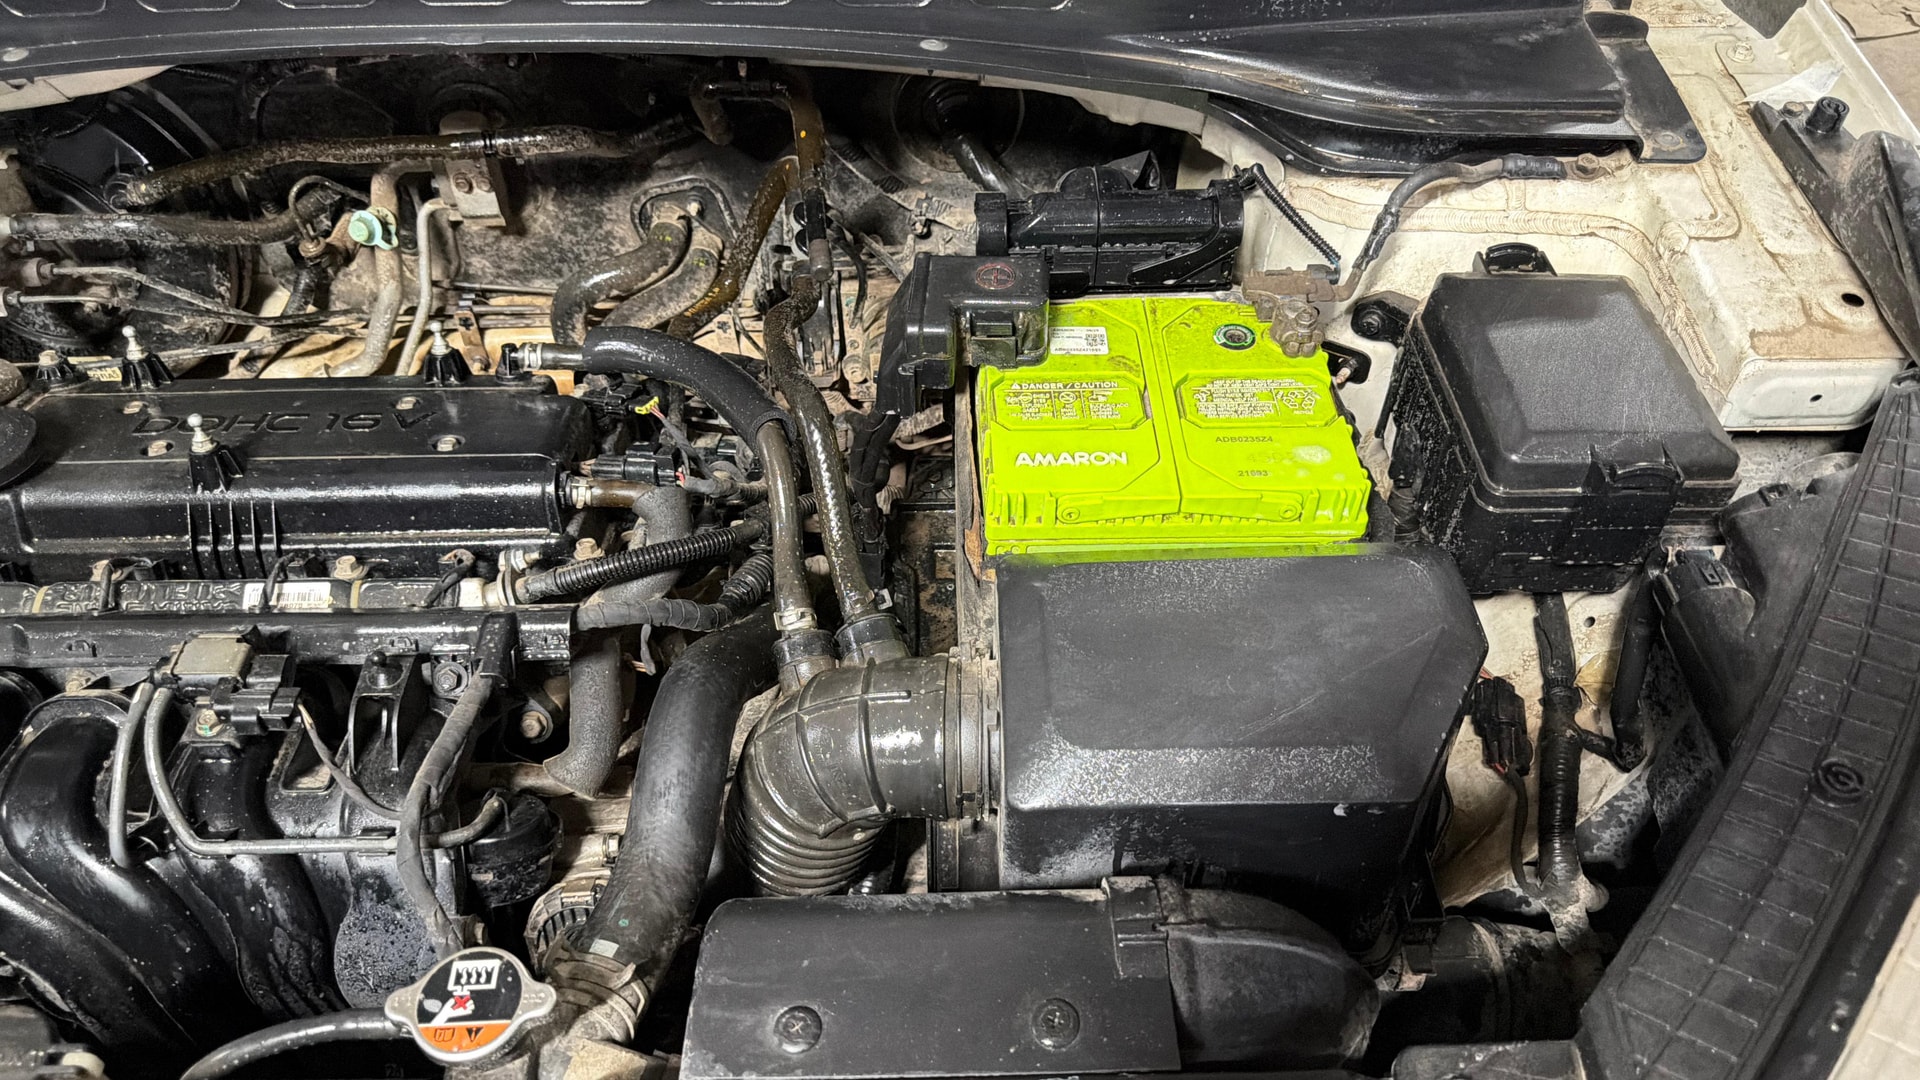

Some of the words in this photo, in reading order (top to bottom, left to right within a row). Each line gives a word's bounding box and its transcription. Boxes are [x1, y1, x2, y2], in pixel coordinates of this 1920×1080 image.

[131, 412, 310, 435] DOHC
[323, 412, 382, 432] 16
[1015, 451, 1127, 467] AMARON
